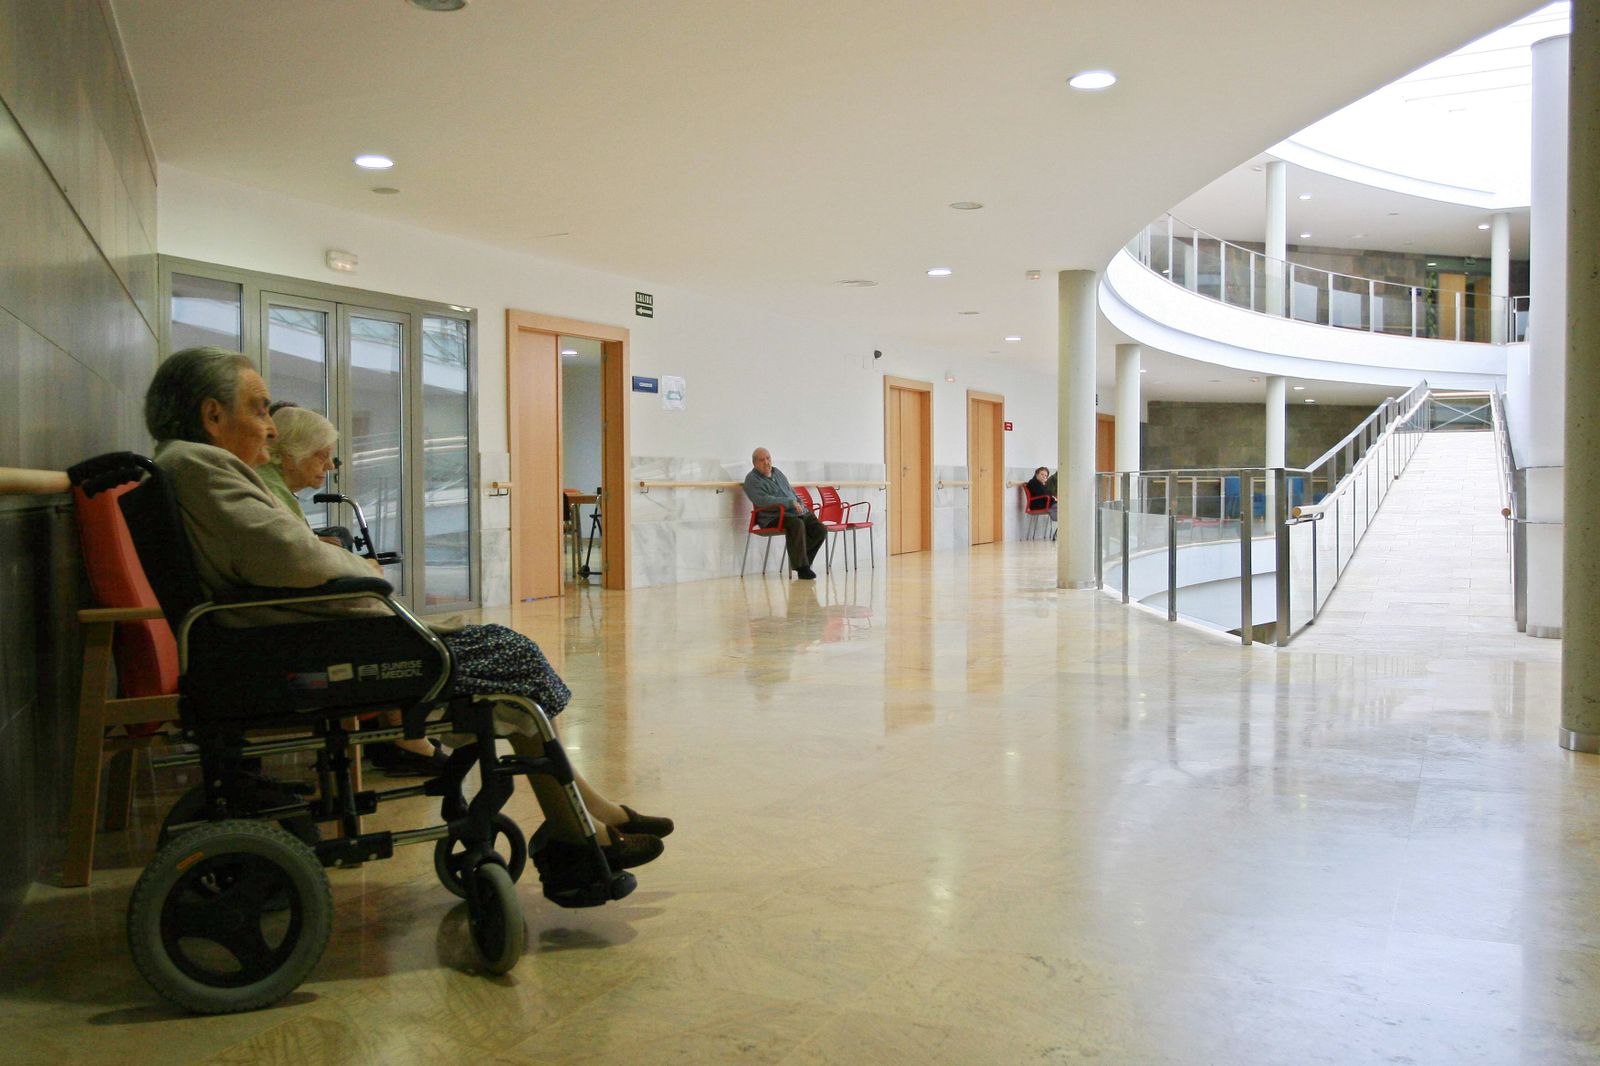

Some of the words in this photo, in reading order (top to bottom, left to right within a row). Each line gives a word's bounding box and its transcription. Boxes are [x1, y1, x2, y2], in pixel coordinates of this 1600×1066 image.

[637, 293, 652, 304] SALIDA
[381, 660, 423, 671] SUNRISE
[382, 668, 423, 680] MEDICAL
